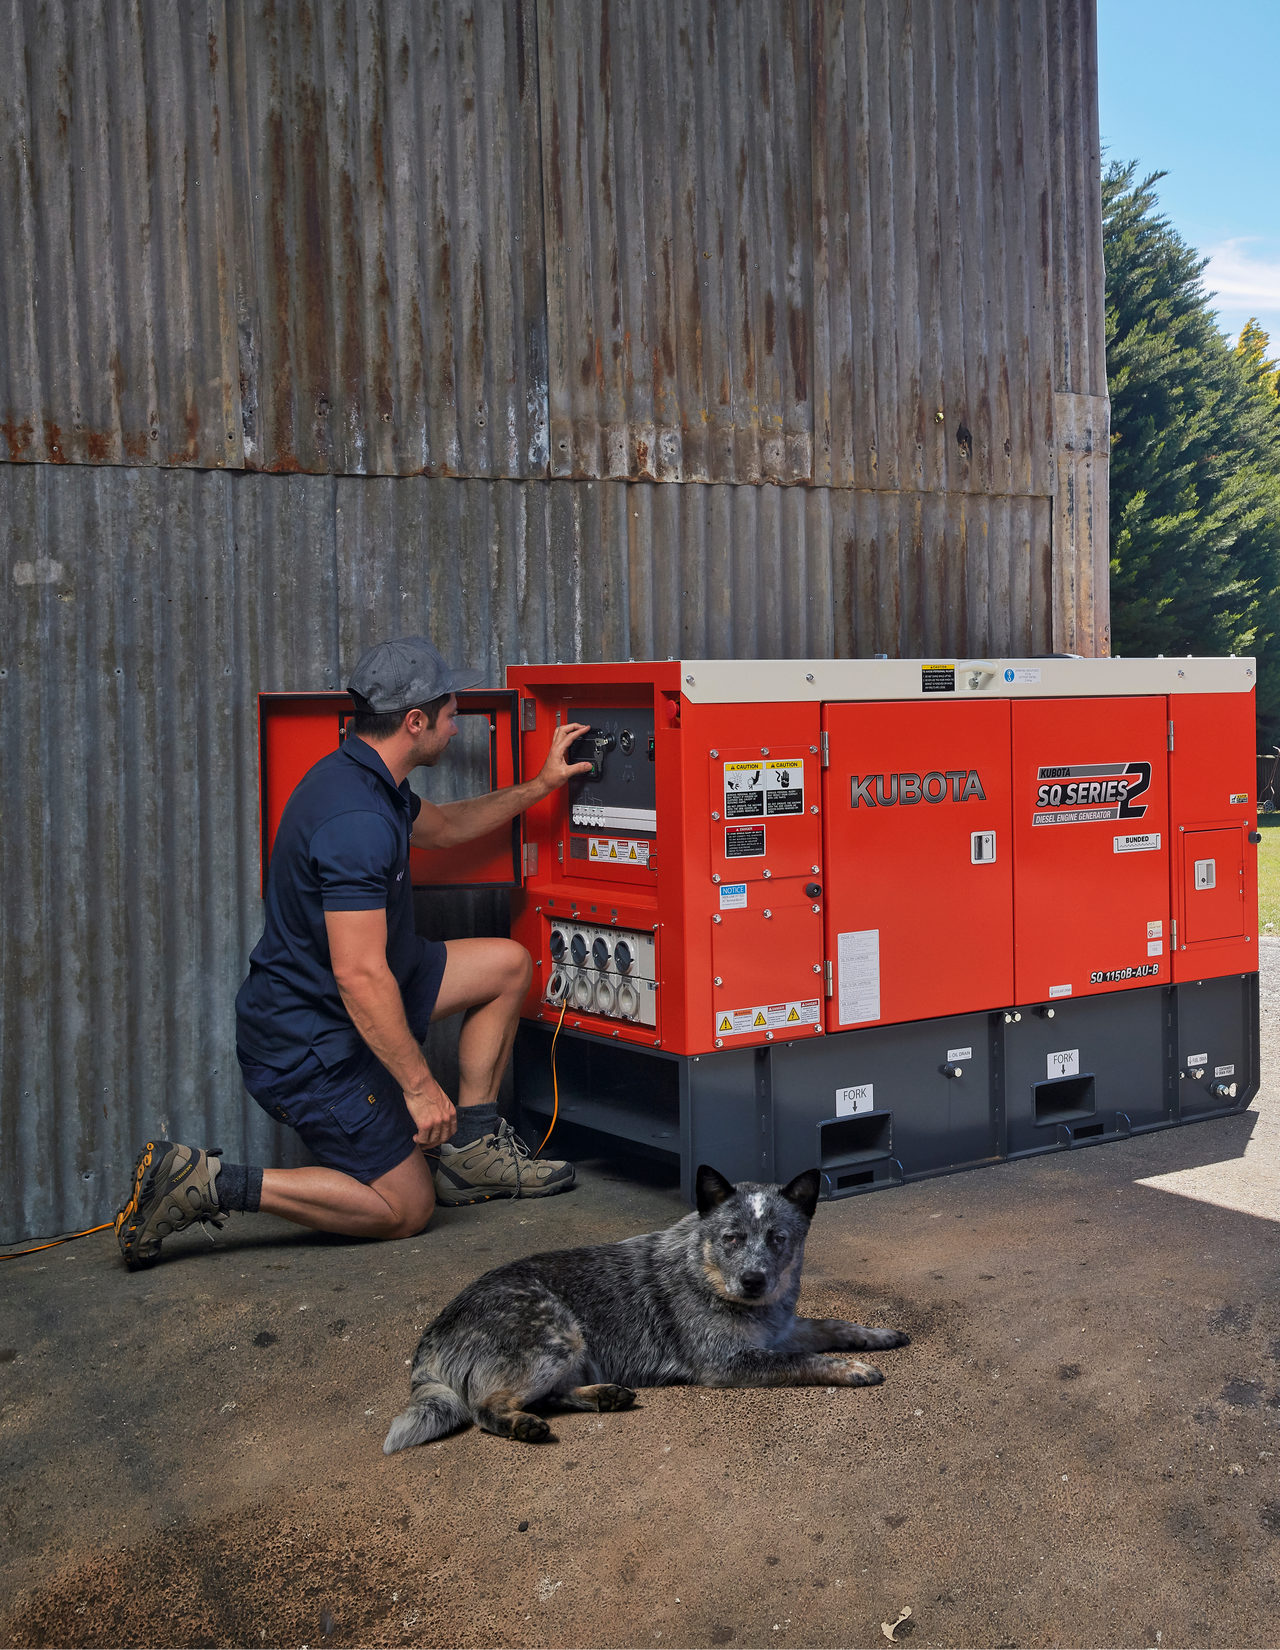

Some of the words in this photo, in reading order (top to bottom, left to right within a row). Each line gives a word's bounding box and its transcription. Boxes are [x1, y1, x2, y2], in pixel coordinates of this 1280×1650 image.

[1040, 768, 1071, 779] KUBOTA
[850, 769, 987, 809] KUBOTA
[1036, 783, 1062, 807] SQ
[1065, 780, 1129, 806] SERIES
[1118, 761, 1152, 819] 2
[1035, 814, 1056, 824] DIESEL
[1057, 812, 1078, 822] ENGINE
[1078, 810, 1111, 821] GENERATOR
[1125, 835, 1150, 844] BUNDED
[722, 886, 744, 895] NOTICE
[1090, 971, 1103, 984] SQ
[1105, 963, 1159, 982] 1150B-AU-B
[1053, 1053, 1074, 1065] FORK
[843, 1087, 867, 1101] FORK
